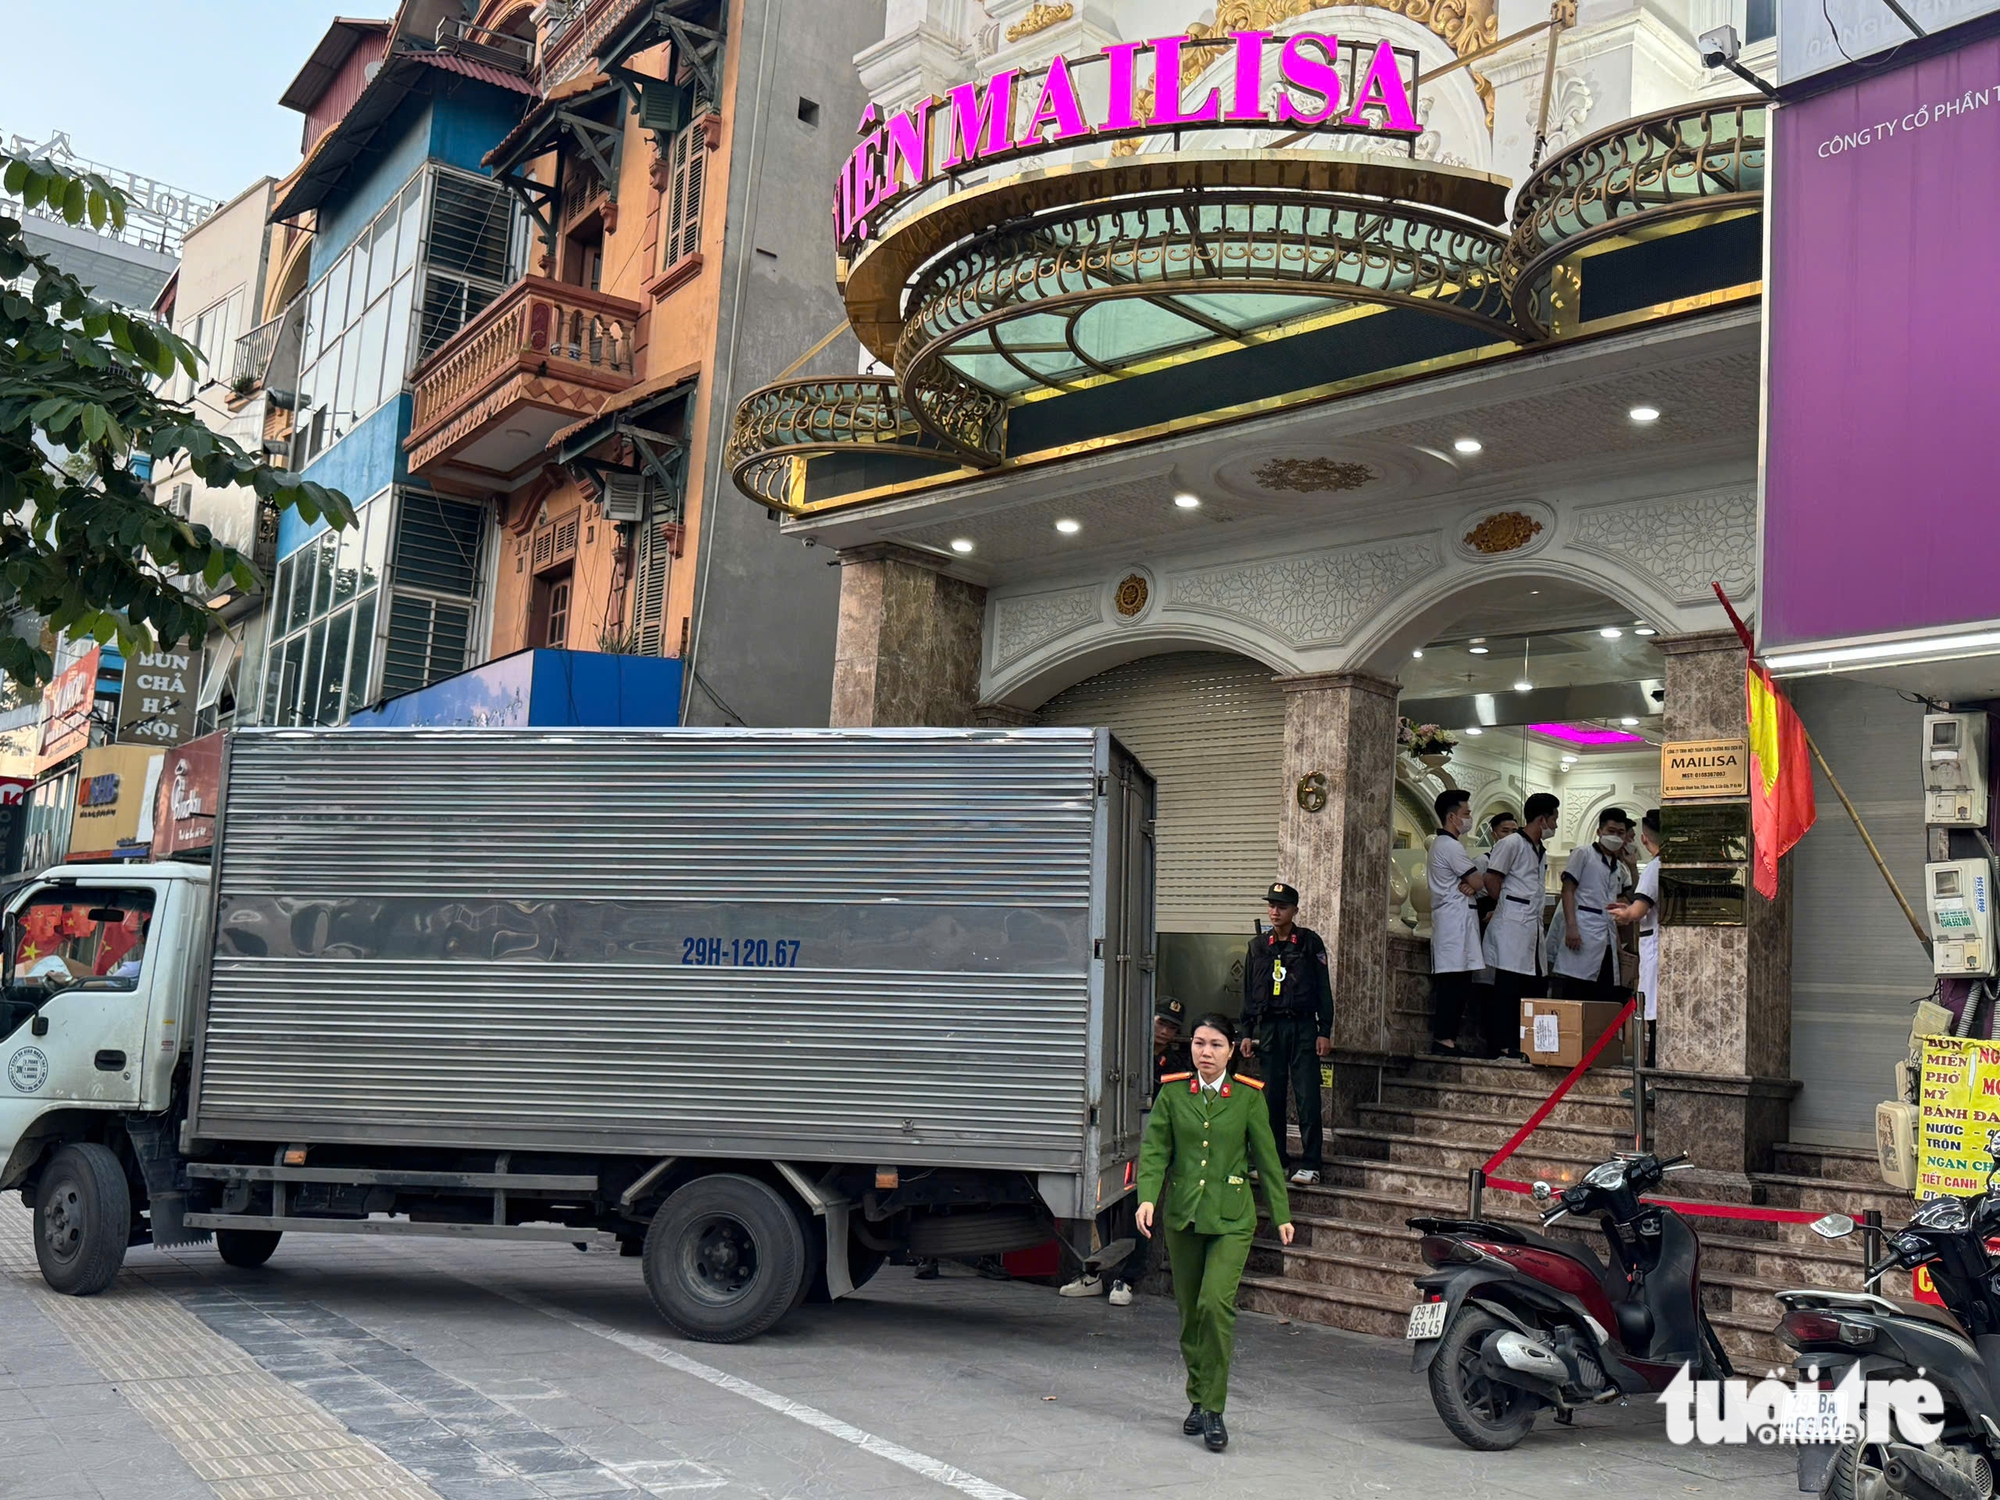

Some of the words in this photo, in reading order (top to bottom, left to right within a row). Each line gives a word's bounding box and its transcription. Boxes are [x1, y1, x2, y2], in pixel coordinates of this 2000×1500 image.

[940, 29, 1424, 170] MAILISA
[1817, 128, 1871, 159] CÔNG
[1874, 118, 1899, 142] TY
[1901, 103, 1930, 132] CỔ
[1934, 90, 1989, 122] PHẦN
[136, 672, 187, 694] CHẢ
[141, 695, 177, 715] HÀ
[134, 718, 180, 741] NỘI
[1670, 755, 1738, 769] MAILISA
[1297, 771, 1327, 812] 6
[681, 936, 801, 968] 29H-120.67
[1927, 1037, 1963, 1051] BÚN
[1925, 1070, 1961, 1084] PHỞ
[1923, 1087, 1949, 1101] MỲ
[1923, 1104, 1969, 1120] BÁNH
[1925, 1121, 1964, 1136] NƯỚC
[1925, 1137, 1962, 1152] TRỘN
[1927, 1155, 1968, 1170] NGAN
[1921, 1171, 1942, 1186] TIẾT
[1944, 1176, 1978, 1190] CANH
[1408, 1320, 1441, 1338] 569.45
